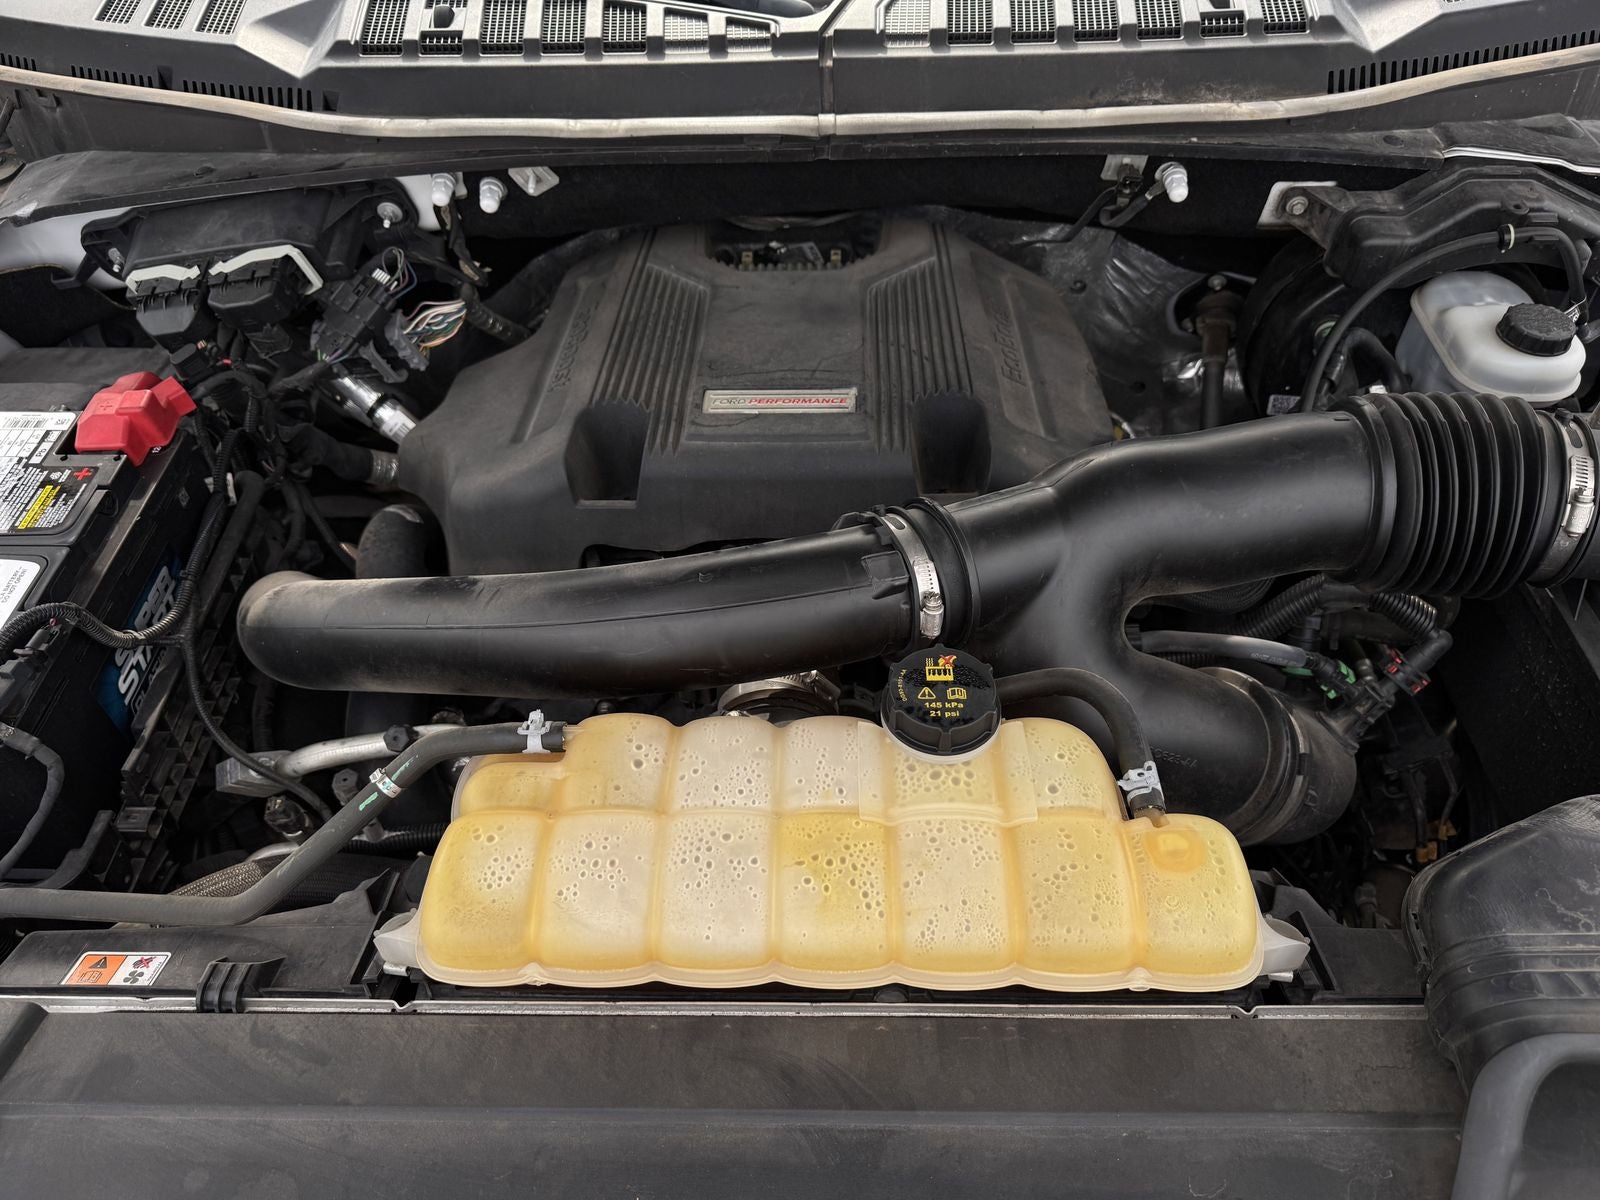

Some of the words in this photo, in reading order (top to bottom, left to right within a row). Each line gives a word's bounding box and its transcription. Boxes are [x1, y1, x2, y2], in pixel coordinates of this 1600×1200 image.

[747, 397, 848, 405] PERFORMANCE
[115, 565, 174, 675] SPER
[945, 710, 960, 718] psi
